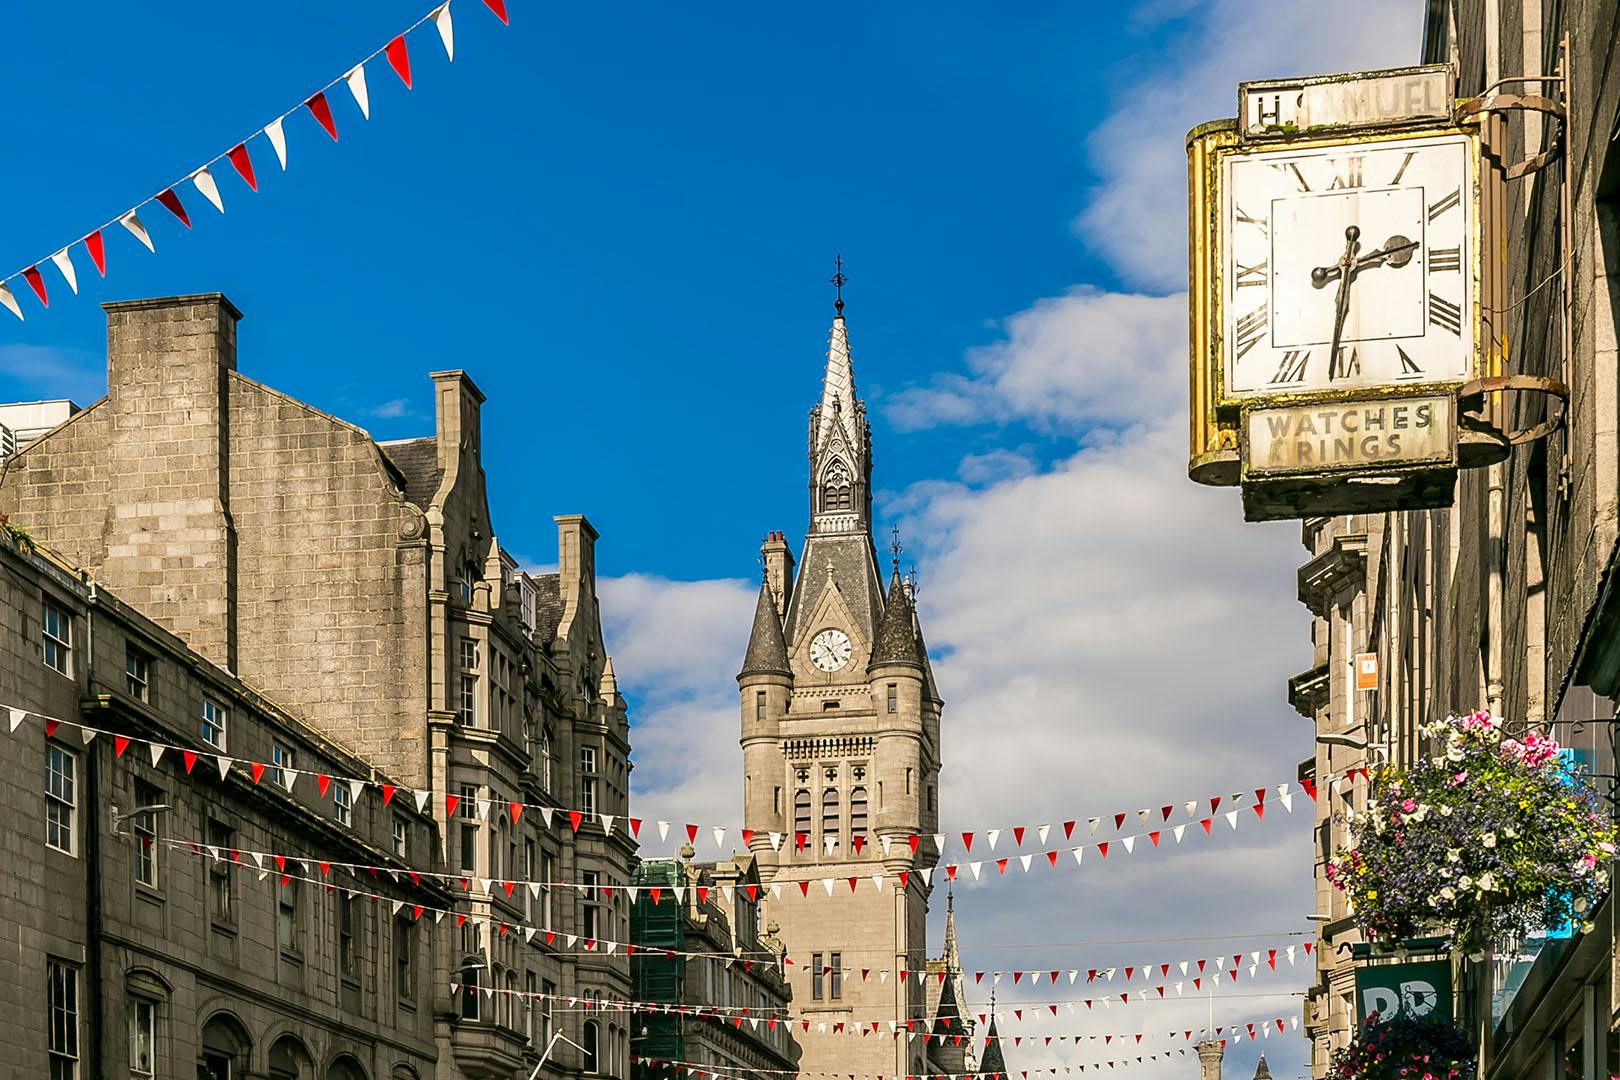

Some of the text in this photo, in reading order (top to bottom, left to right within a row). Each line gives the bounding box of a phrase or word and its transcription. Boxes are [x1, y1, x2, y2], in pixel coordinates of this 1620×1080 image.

[1258, 95, 1280, 125] H
[1267, 404, 1431, 439] WATCHES
[1297, 433, 1402, 465] RINGS
